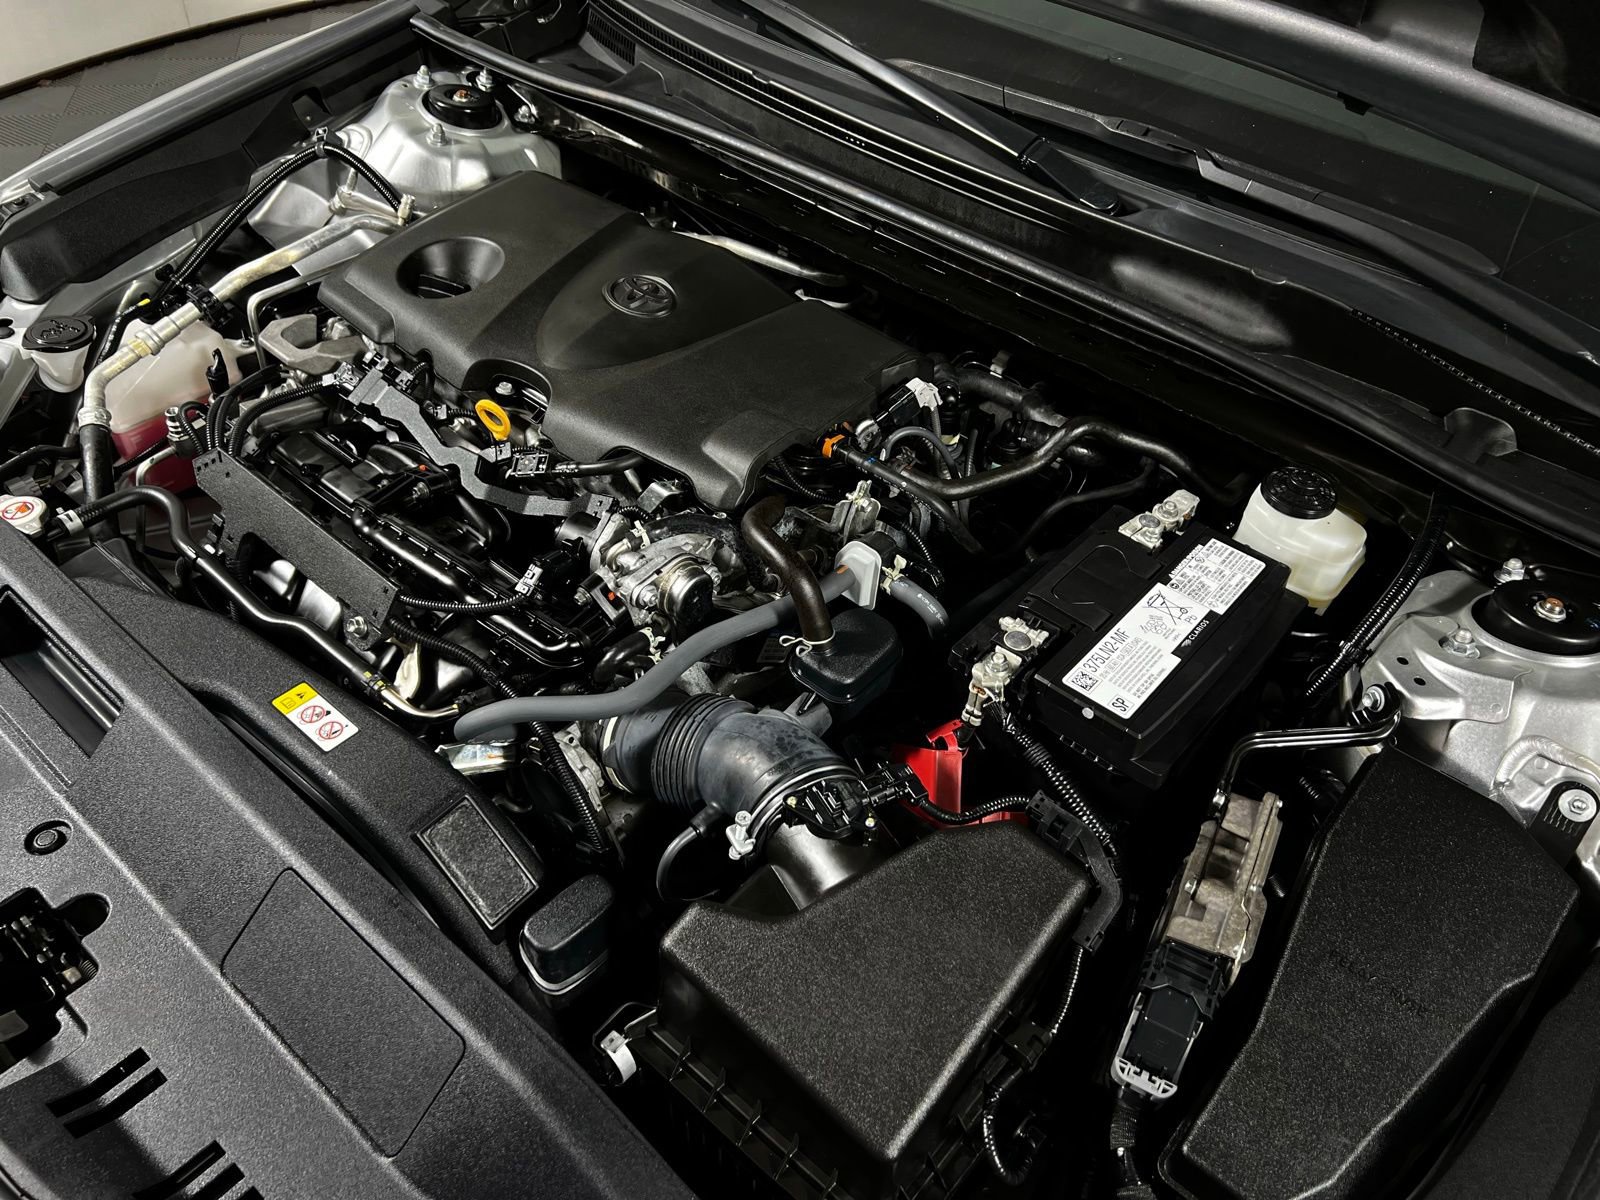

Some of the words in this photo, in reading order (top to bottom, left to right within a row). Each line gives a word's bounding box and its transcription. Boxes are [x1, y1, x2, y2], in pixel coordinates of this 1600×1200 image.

[1189, 619, 1210, 641] CLARIOS
[1083, 628, 1129, 673] 375LN2-MF
[1111, 697, 1130, 712] SP
